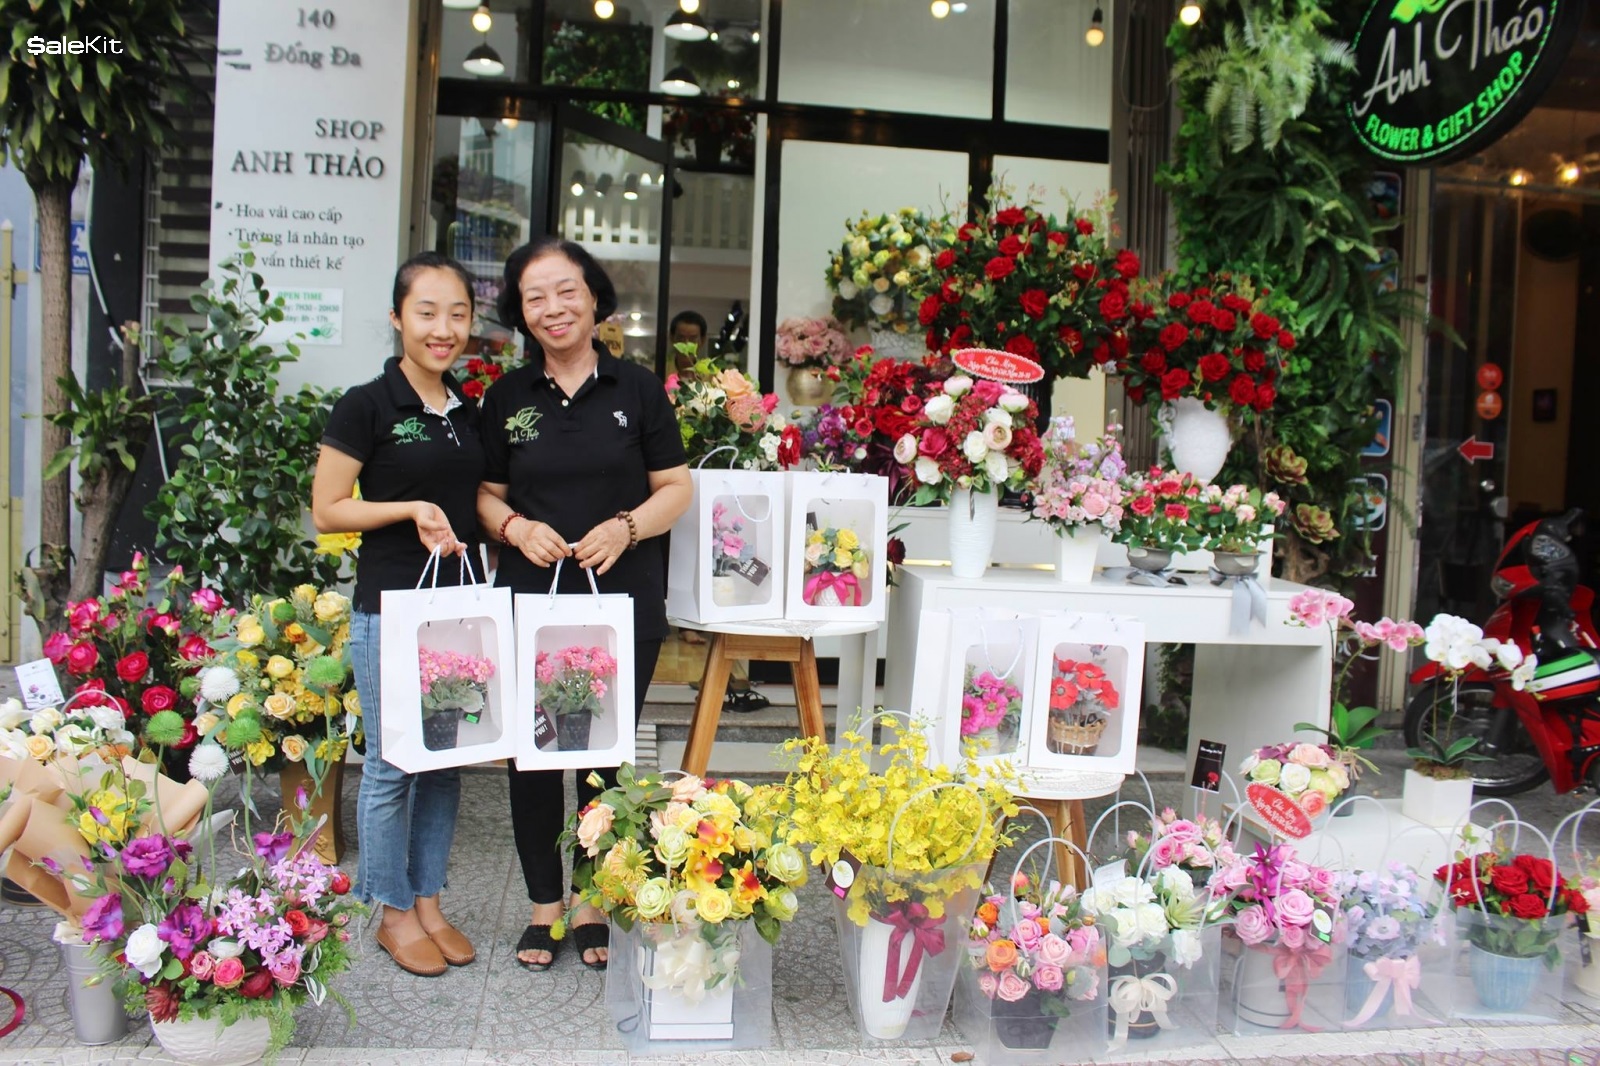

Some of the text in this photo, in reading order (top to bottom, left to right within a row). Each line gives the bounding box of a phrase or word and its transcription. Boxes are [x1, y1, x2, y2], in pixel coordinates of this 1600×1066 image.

[297, 8, 336, 28] 140
[265, 41, 362, 69] Đống Đa
[1353, 21, 1431, 117] Anh
[1364, 50, 1523, 152] FLOWER & GIFT SHOP
[315, 118, 384, 141] SHOP
[231, 147, 385, 179] ANH THẢO
[236, 203, 264, 219] Hoa
[292, 209, 315, 221] cao
[318, 206, 342, 225] cấp
[288, 229, 299, 244] lá
[303, 230, 338, 246] nhân
[343, 234, 365, 250] tạo
[261, 251, 285, 267] vấn
[290, 254, 321, 269] thiết
[326, 256, 344, 270] kế
[303, 291, 322, 301] TIME
